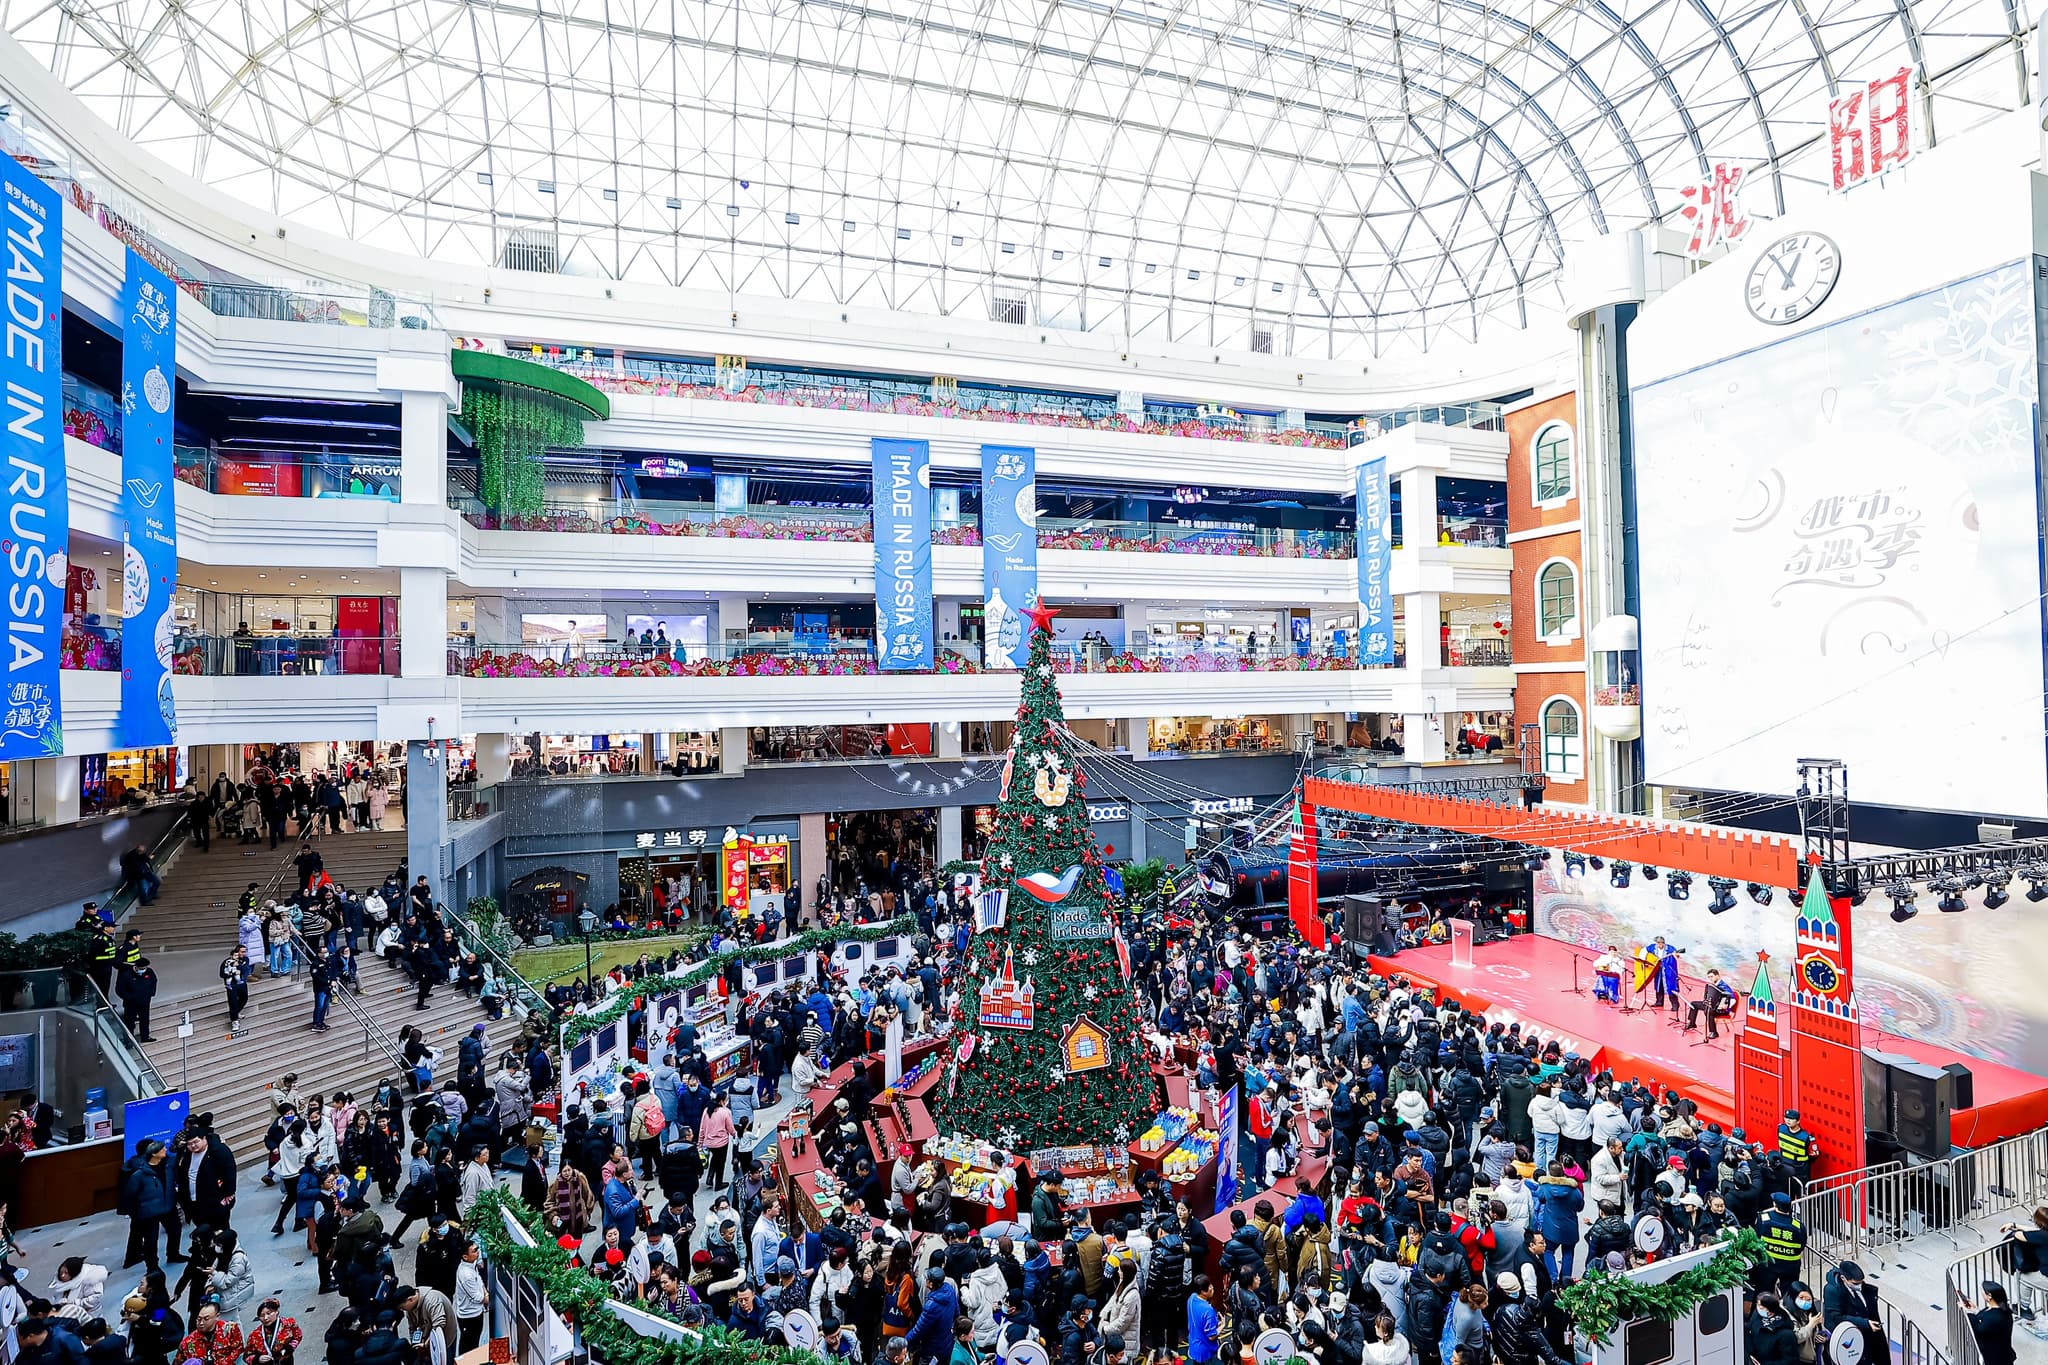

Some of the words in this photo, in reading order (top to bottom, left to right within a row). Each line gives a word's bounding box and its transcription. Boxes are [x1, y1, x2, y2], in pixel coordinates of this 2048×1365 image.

[1680, 67, 1912, 255] 沈阳
[4, 180, 47, 221] 俄罗斯制造
[1782, 238, 1798, 254] 12
[1820, 256, 1834, 272] 3
[7, 202, 44, 373] MADE
[1750, 285, 1762, 300] 9
[1785, 304, 1797, 319] 6
[7, 381, 44, 444] IN
[891, 461, 912, 517] MADE
[1366, 473, 1380, 530] MADE
[146, 516, 163, 530] Made
[893, 524, 913, 543] IN
[1368, 535, 1380, 554] IN
[9, 456, 46, 673] RUSSIA
[894, 550, 914, 626] RUSSIA
[1368, 558, 1382, 627] RUSSIA
[636, 830, 707, 848] 麦当劳
[756, 834, 788, 845] 甜品站
[1053, 910, 1087, 922] Made
[1055, 925, 1066, 937] in
[1069, 924, 1108, 937] Russia
[1556, 1035, 1579, 1053] IN
[1771, 1227, 1793, 1241] 警察
[1768, 1244, 1795, 1255] POLICE
